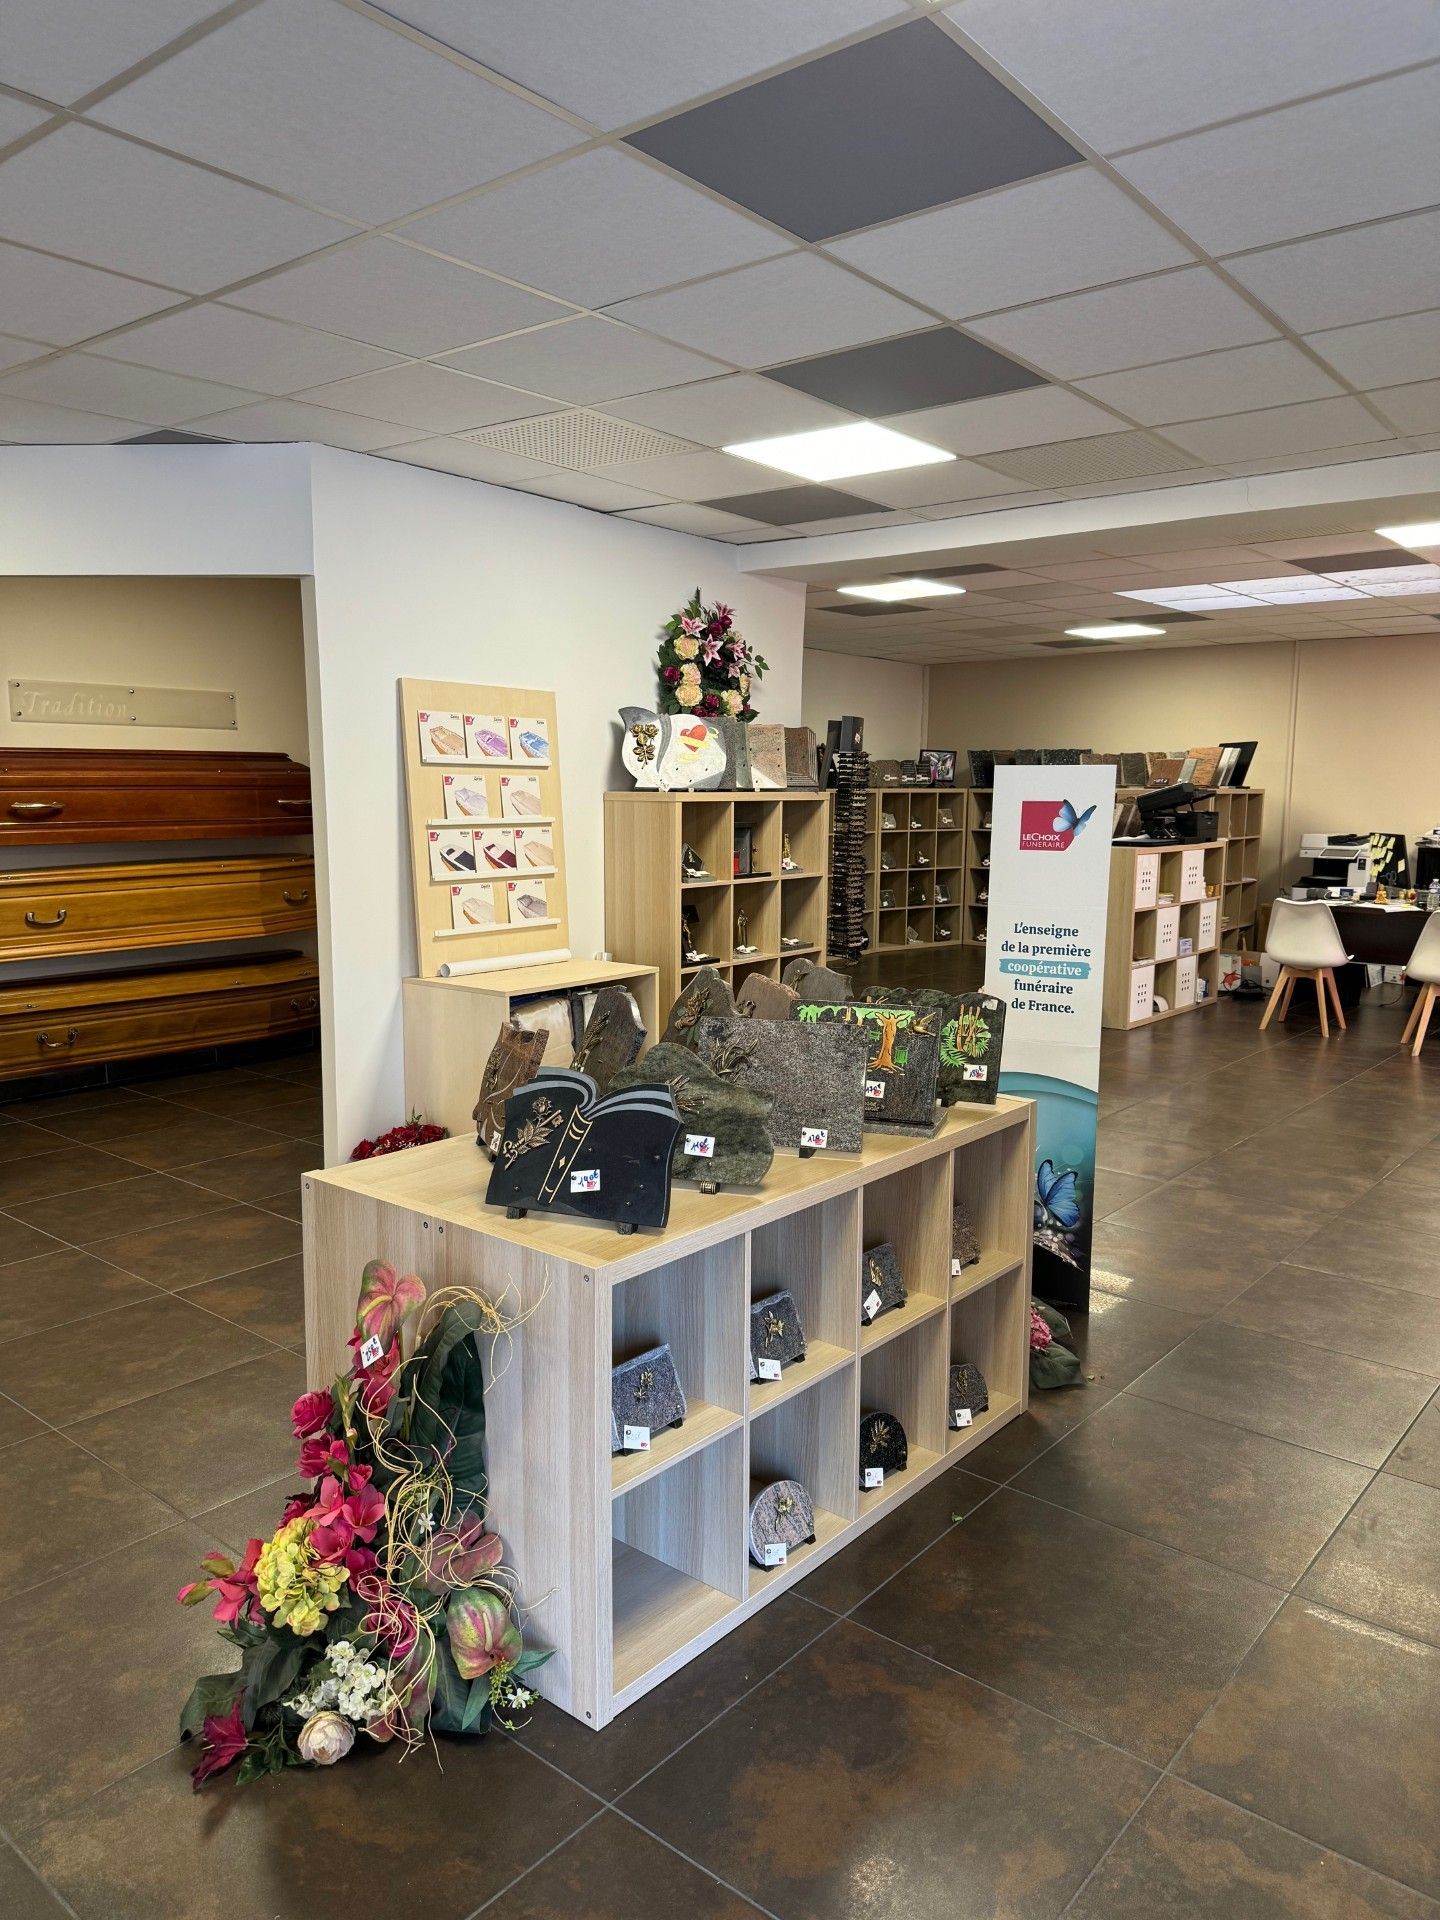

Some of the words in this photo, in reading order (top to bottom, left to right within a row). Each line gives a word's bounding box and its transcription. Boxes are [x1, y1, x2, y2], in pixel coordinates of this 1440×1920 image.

[23, 691, 127, 717] Tradition
[1014, 922, 1079, 938] L'enseigne
[1001, 941, 1016, 952] de
[1018, 942, 1029, 953] la
[1032, 944, 1091, 957] première
[1007, 961, 1082, 975] coopérative
[1014, 979, 1073, 994] funéraire
[1011, 998, 1026, 1009] de
[1028, 1000, 1075, 1014] France.
